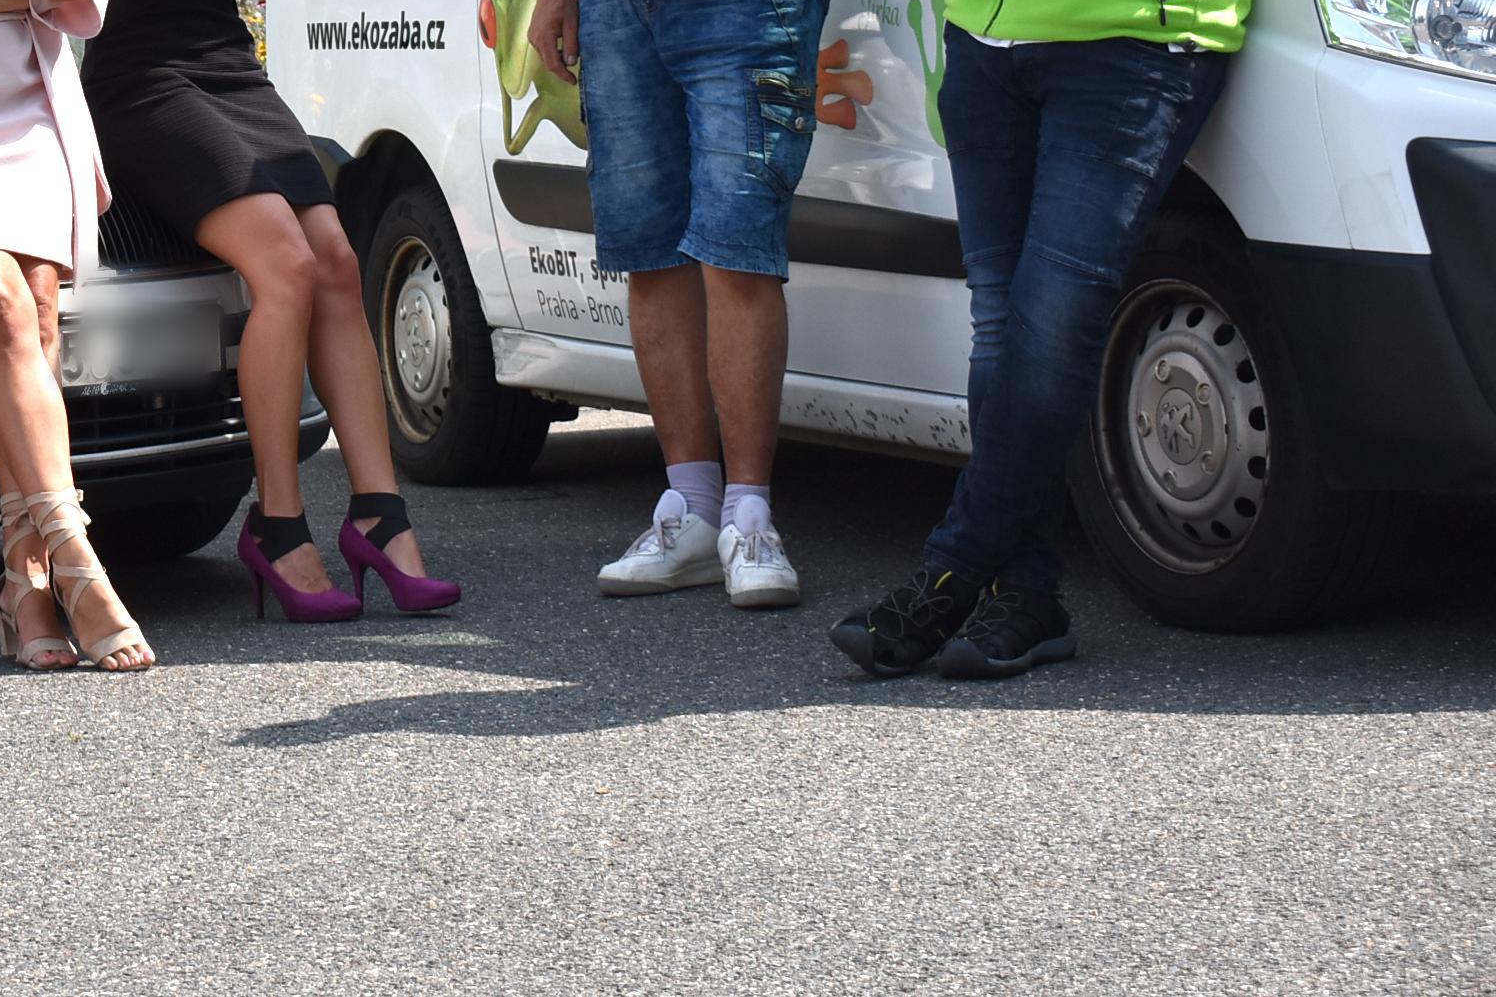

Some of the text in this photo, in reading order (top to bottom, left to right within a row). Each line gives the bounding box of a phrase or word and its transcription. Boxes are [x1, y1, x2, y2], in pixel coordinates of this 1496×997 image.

[307, 10, 445, 50] www.ekozaba.cz
[529, 245, 584, 284] EkoBIT,
[537, 289, 579, 320] Praha
[587, 295, 624, 326] Brno
